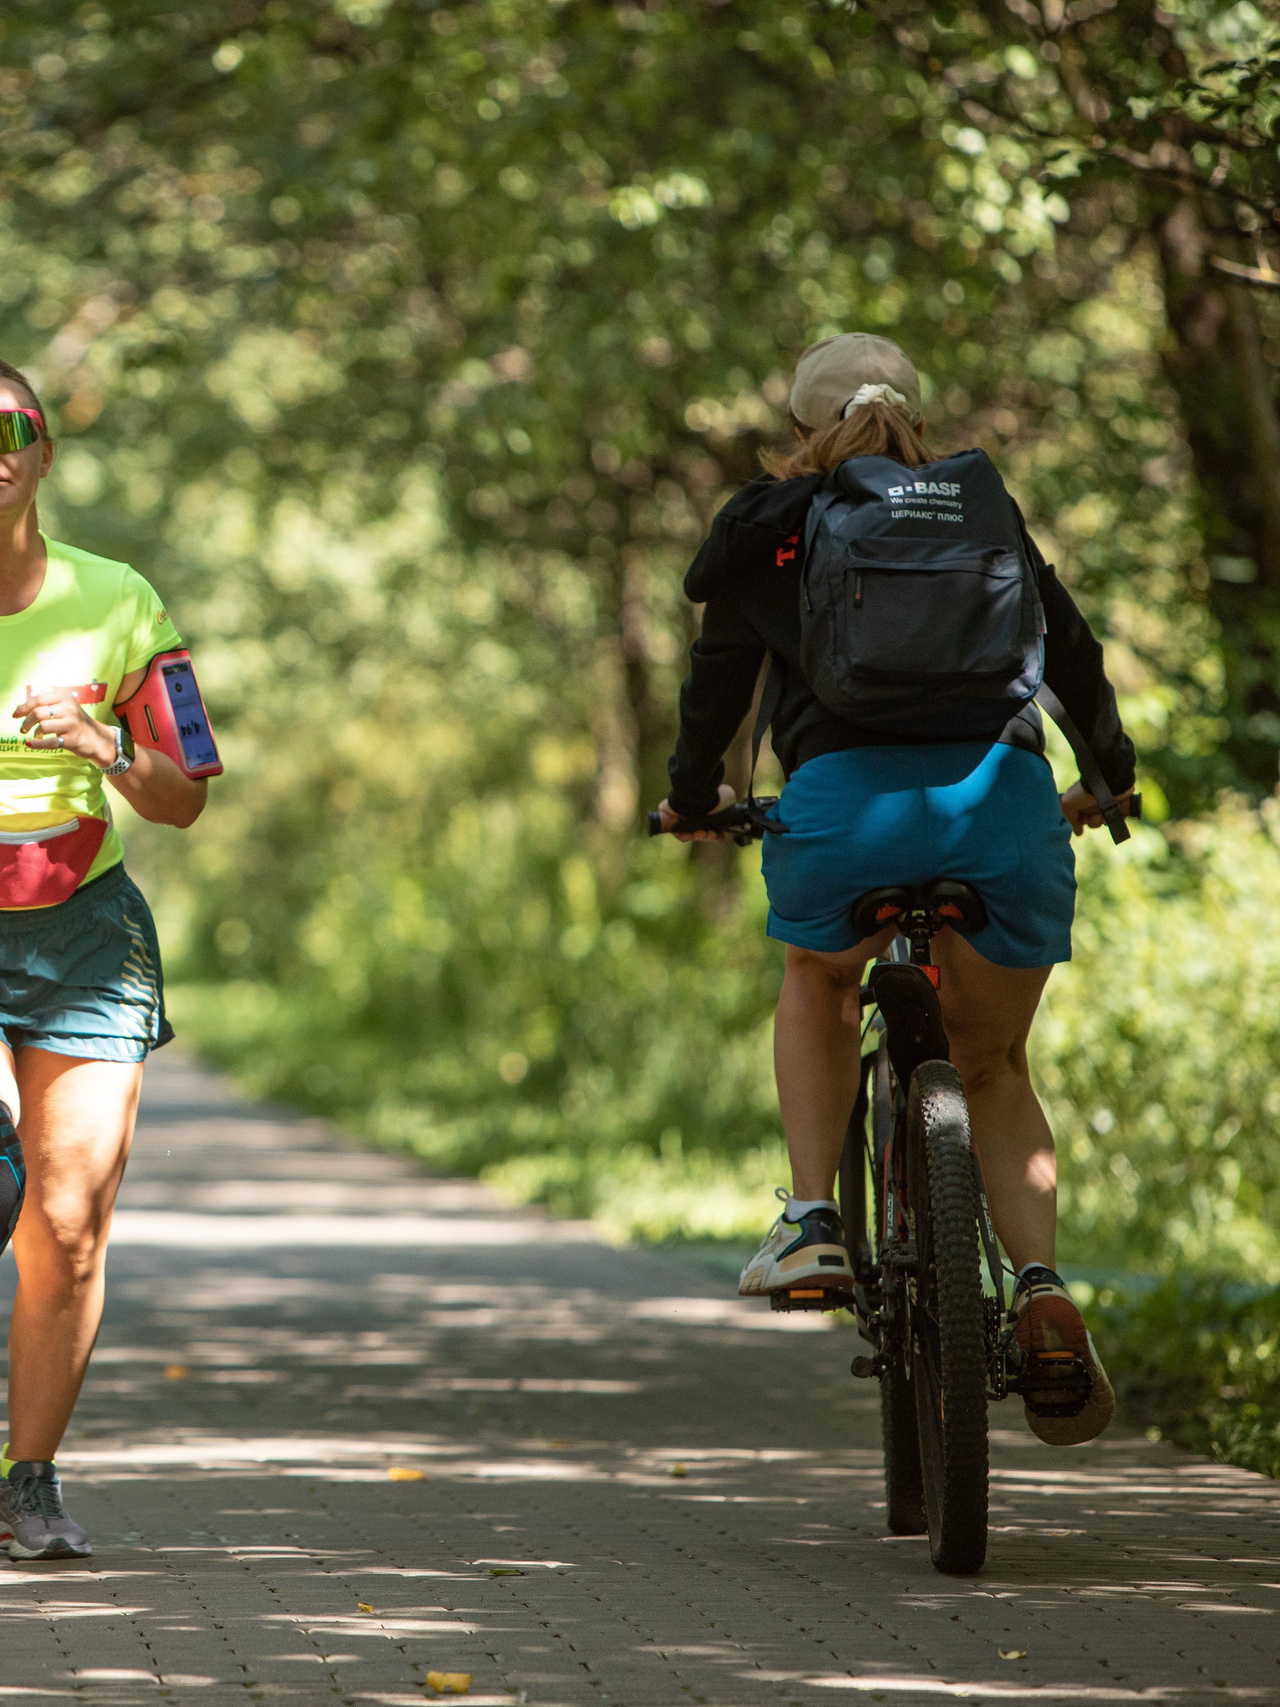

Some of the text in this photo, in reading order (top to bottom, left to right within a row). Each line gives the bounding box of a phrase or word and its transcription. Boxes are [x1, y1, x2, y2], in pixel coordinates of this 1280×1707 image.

[914, 481, 961, 497] BASF
[929, 498, 963, 509] chemistry
[937, 512, 964, 522] ПЛЮС
